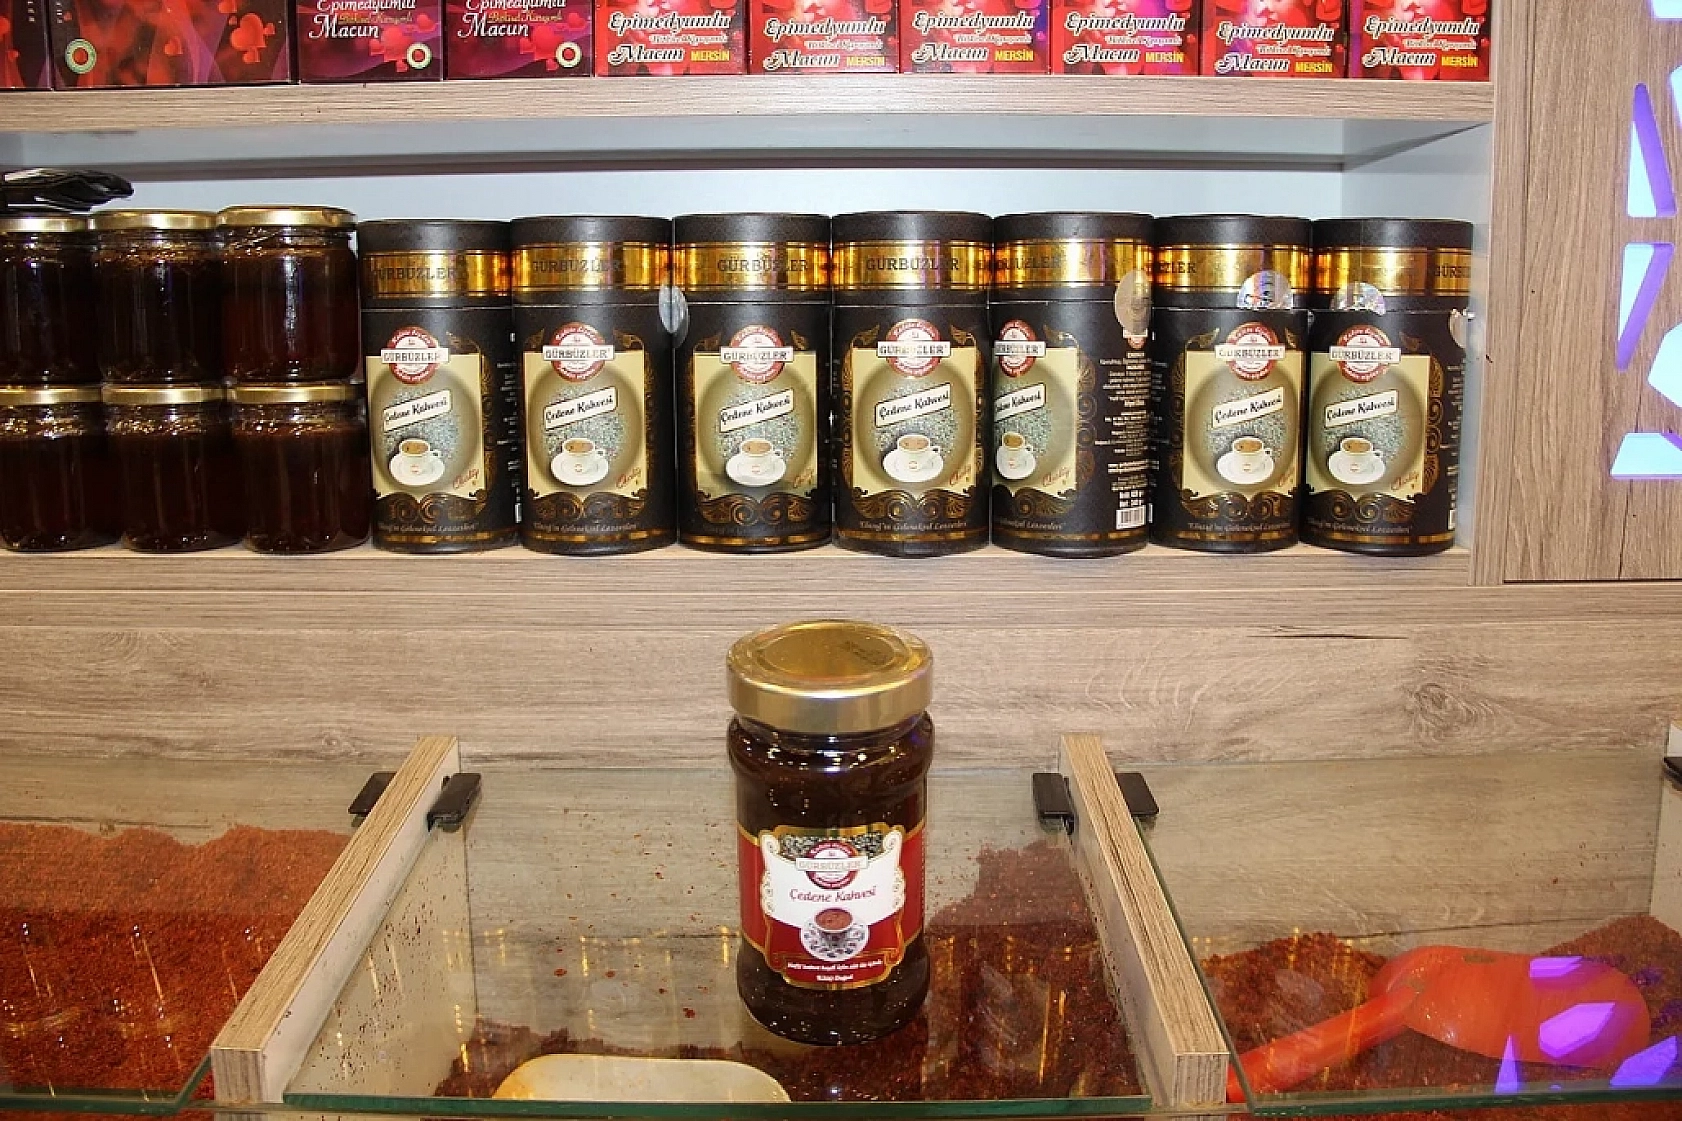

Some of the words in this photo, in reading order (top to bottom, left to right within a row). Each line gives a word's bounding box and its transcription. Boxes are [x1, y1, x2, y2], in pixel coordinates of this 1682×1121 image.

[308, 14, 379, 38] Macun
[457, 13, 529, 37] Macun
[608, 10, 731, 36] Epimedyumlu
[763, 16, 887, 43] Epimedyumlu
[912, 10, 1035, 36] Epimedyumlu
[1064, 12, 1186, 36] Epimedyumlu
[1216, 21, 1335, 46] Epimedyumlu
[1364, 15, 1480, 40] Epimedyumlu
[608, 44, 685, 65] Macun
[763, 49, 840, 71] Macun
[911, 42, 990, 62] Macun
[1063, 44, 1141, 64] Macun
[1362, 47, 1437, 68] Macun
[1214, 53, 1291, 74] Macun
[545, 348, 609, 359] GÜRBÜZLER
[411, 397, 448, 415] Kahvesi
[576, 395, 614, 413] Kahvesi
[756, 396, 790, 414] Kahvesi
[915, 390, 949, 409] Kahvesi
[1011, 391, 1042, 408] Kahvesi
[1249, 394, 1282, 412] Kahvesi
[1357, 397, 1395, 414] Kahvesi
[789, 888, 831, 902] Çedene
[835, 886, 876, 901] Kahvesi
